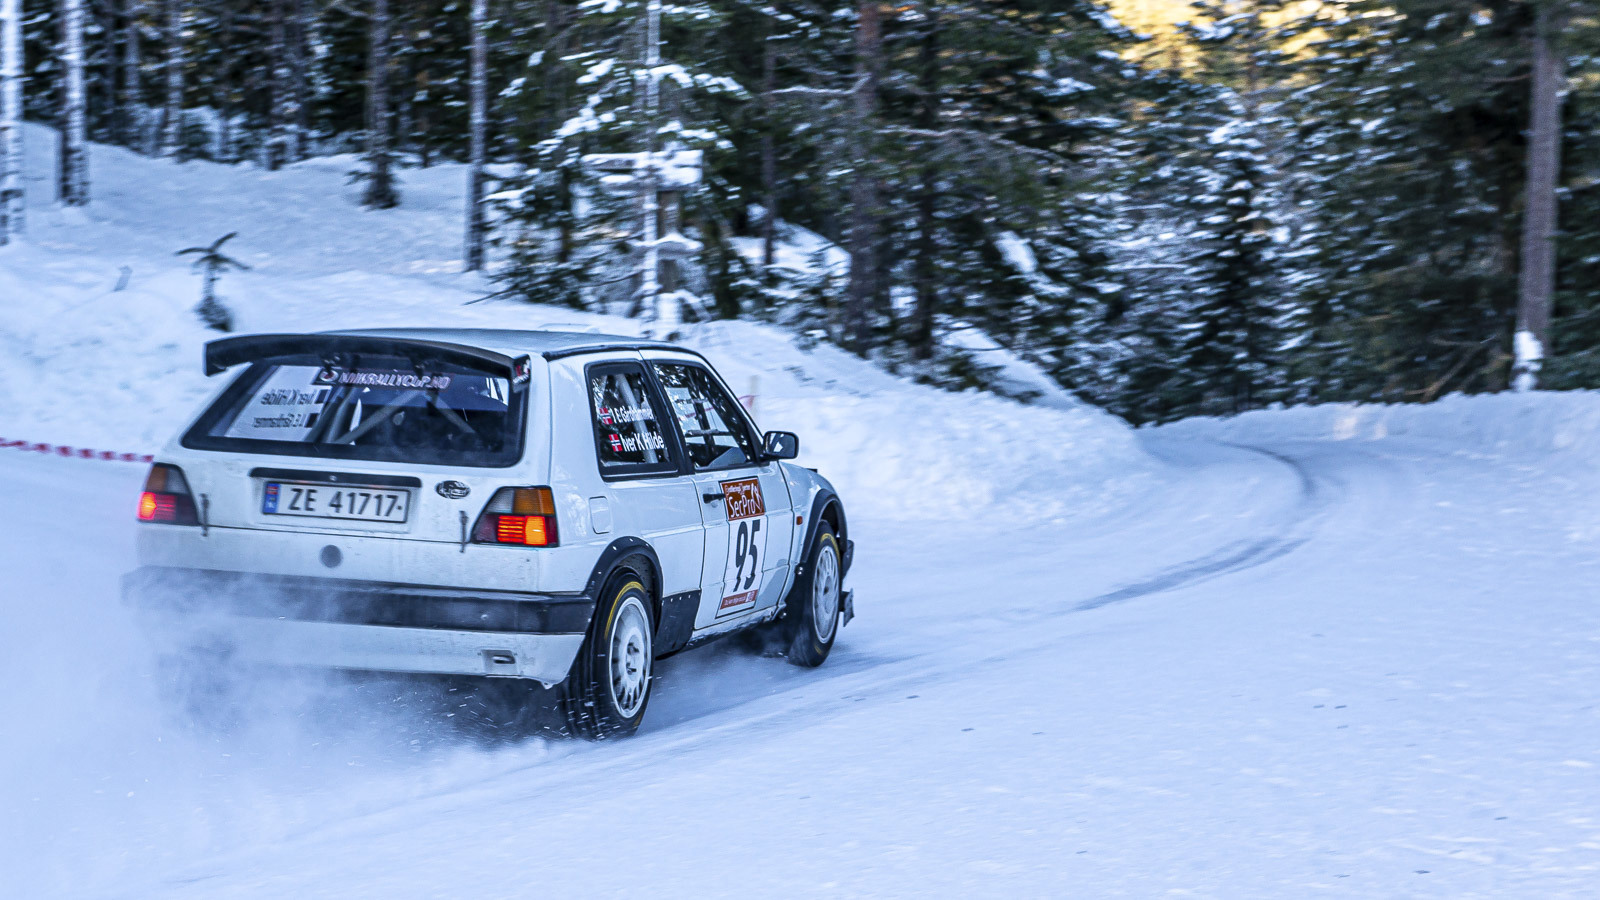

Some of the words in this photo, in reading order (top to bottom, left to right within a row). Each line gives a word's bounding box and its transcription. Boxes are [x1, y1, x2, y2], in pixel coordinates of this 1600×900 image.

[619, 433, 638, 452] Iver
[634, 432, 646, 451] K
[641, 431, 665, 450] Hilde
[287, 488, 318, 511] ZE
[328, 490, 399, 517] 41717
[728, 494, 756, 518] SecPro
[733, 519, 761, 592] 95
